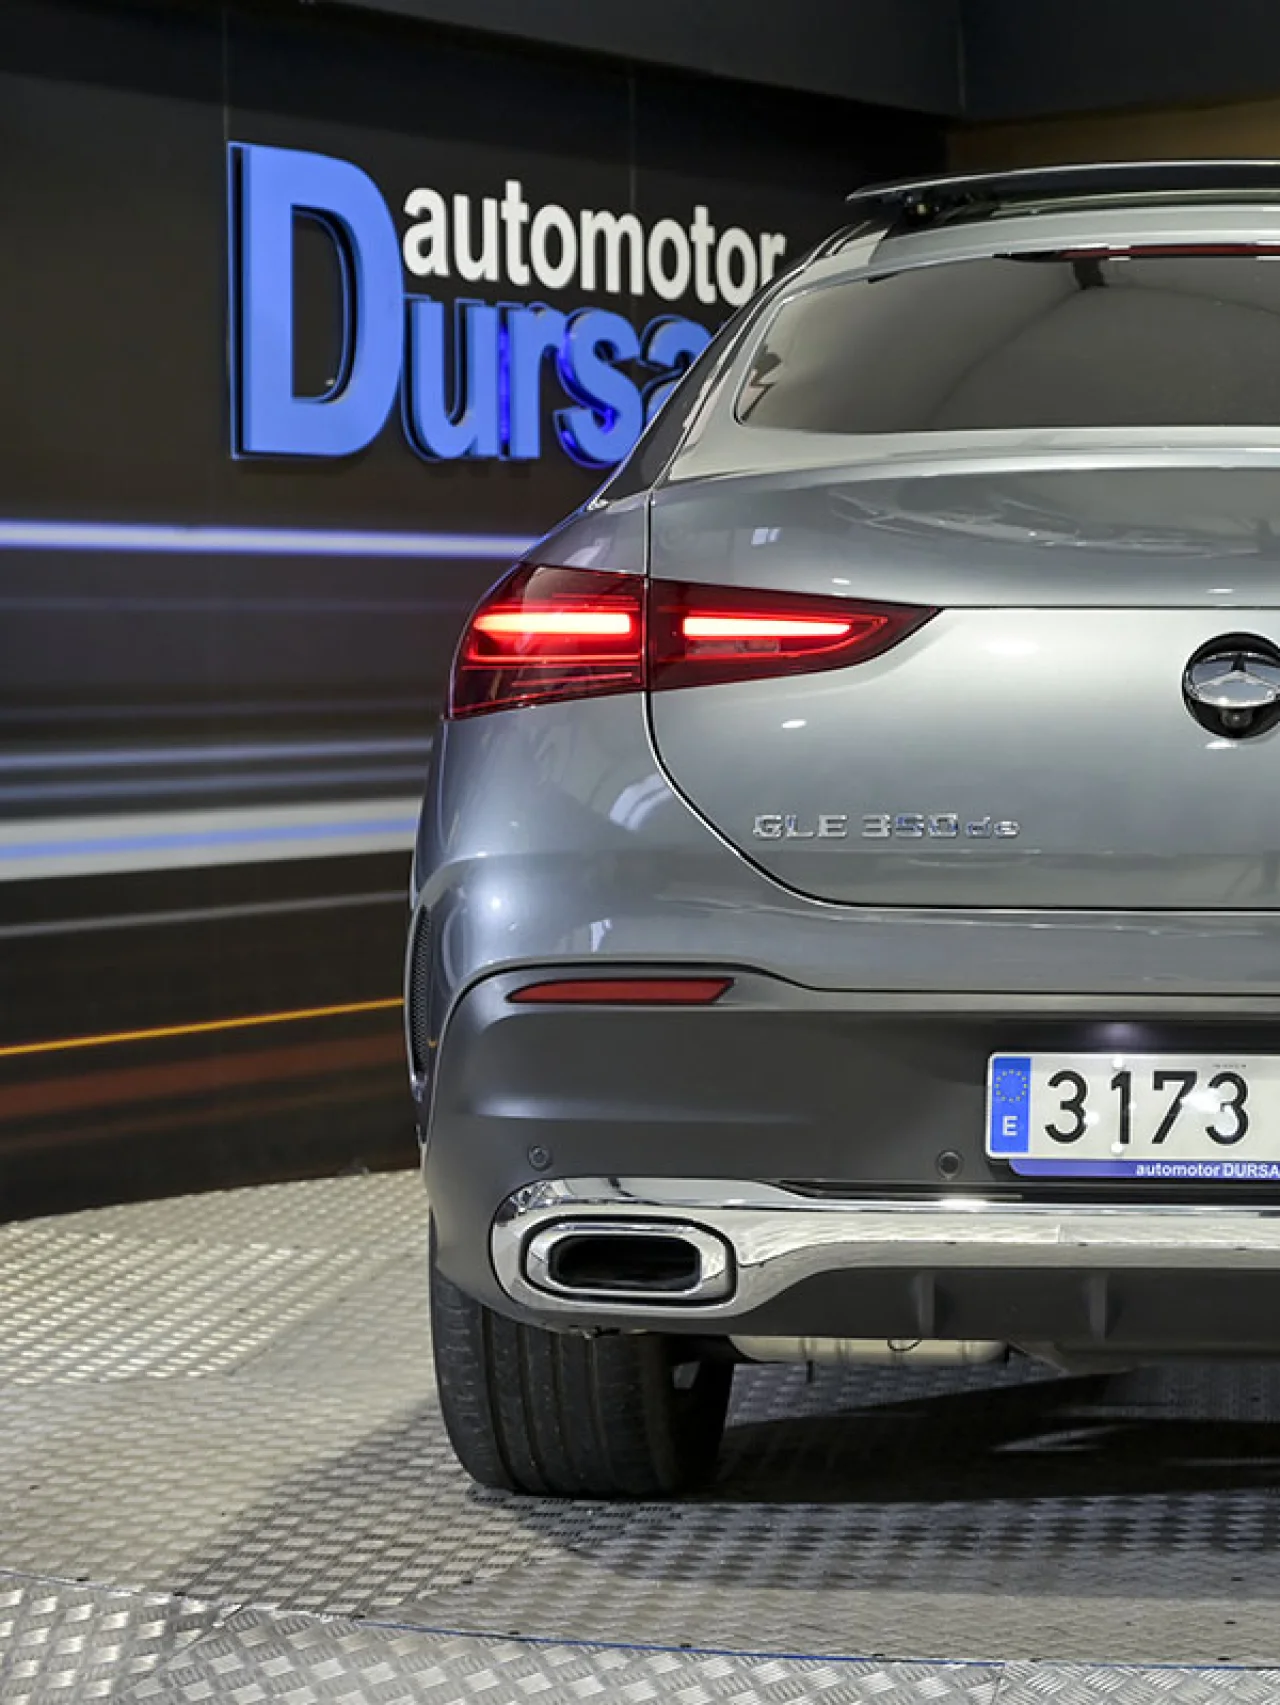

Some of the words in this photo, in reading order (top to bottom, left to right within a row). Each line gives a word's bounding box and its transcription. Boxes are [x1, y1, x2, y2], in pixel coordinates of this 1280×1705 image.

[402, 179, 787, 306] automotor
[753, 813, 848, 838] GLE
[1001, 1115, 1019, 1136] E
[1044, 1069, 1250, 1146] 3173
